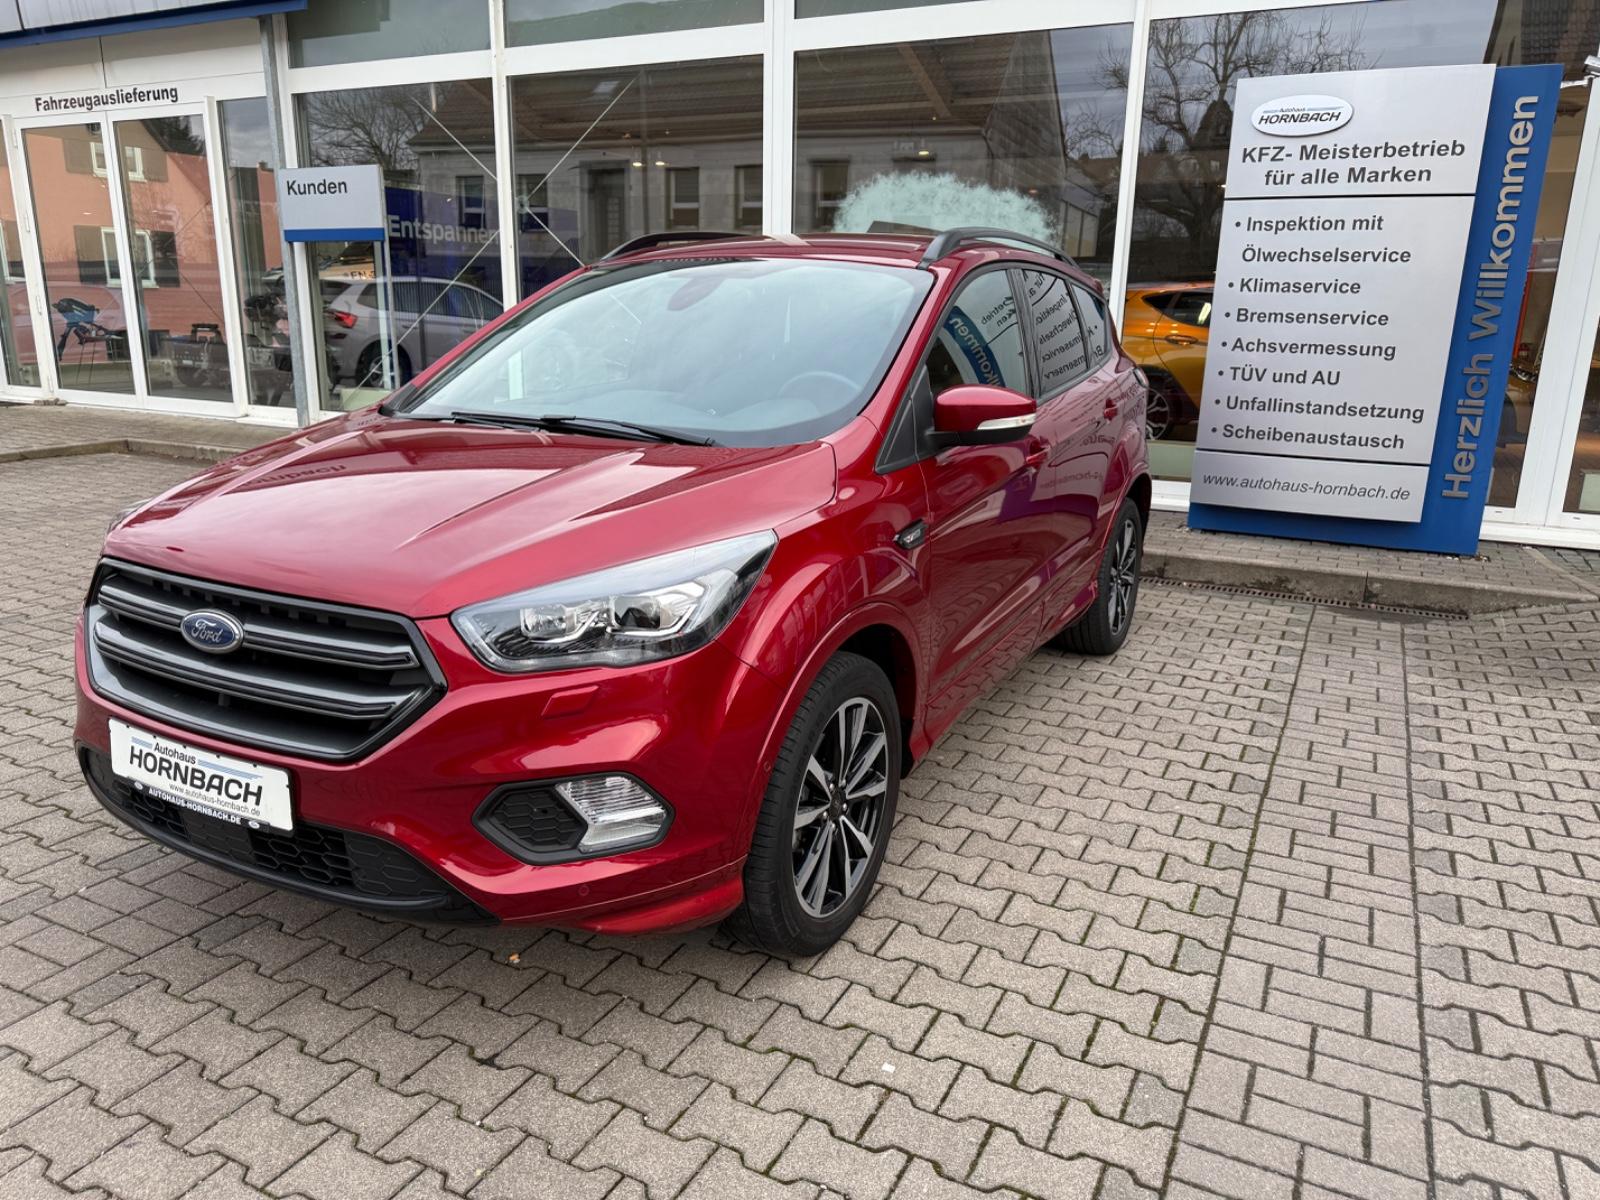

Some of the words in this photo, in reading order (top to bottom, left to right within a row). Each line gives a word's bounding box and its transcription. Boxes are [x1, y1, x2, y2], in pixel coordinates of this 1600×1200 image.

[35, 87, 178, 111] Fahrzeugauslieferung
[1279, 106, 1306, 114] Autohaus
[1258, 111, 1341, 125] HORNBACH
[1242, 145, 1293, 163] KFZ-
[1299, 140, 1466, 161] Meisterbetrieb
[286, 179, 348, 196] Kunden
[1264, 169, 1295, 186] für
[1301, 168, 1339, 185] alle
[1347, 166, 1432, 184] Marken
[1246, 216, 1345, 235] Inspektion
[1352, 215, 1384, 231] mit
[1241, 244, 1412, 263] Ölwechselservice
[1239, 278, 1361, 294] Klimaservice
[1441, 353, 1494, 500] Herzlich
[1468, 95, 1539, 341] Willkommen
[1236, 308, 1389, 326] Bremsenservice
[1231, 337, 1396, 361] Achsvermessung
[1230, 364, 1267, 382] TÜV
[1272, 370, 1307, 384] und
[1312, 371, 1341, 385] AU
[1226, 395, 1425, 424] Unfallinstandsetzung
[1222, 424, 1405, 449] Scheibenaustausch
[1203, 473, 1410, 501] www.autohaus-hornbach.de
[191, 618, 224, 643] Ford
[154, 742, 197, 765] Autohaus
[129, 745, 263, 807] HORNBACH
[148, 787, 242, 825] AUTOHAUS-HORNBACH.DE
[169, 782, 261, 817] www.autohaus-hornbach.de
